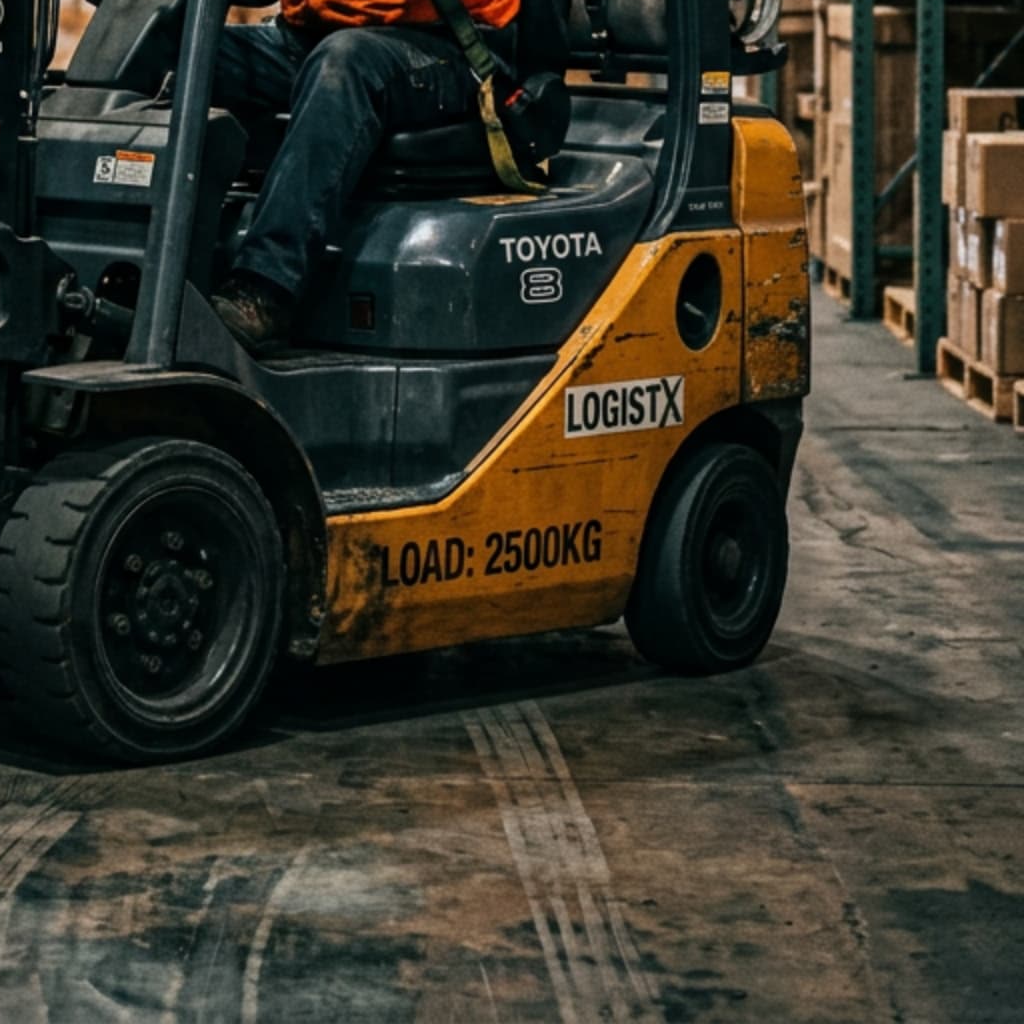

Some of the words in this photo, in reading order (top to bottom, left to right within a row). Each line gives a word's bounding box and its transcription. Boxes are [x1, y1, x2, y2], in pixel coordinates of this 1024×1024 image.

[499, 231, 603, 263] TOYOTA
[520, 267, 563, 304] 8
[567, 376, 683, 433] LOGISTX
[382, 538, 474, 587] LOAD:
[484, 519, 602, 576] 2500KG
